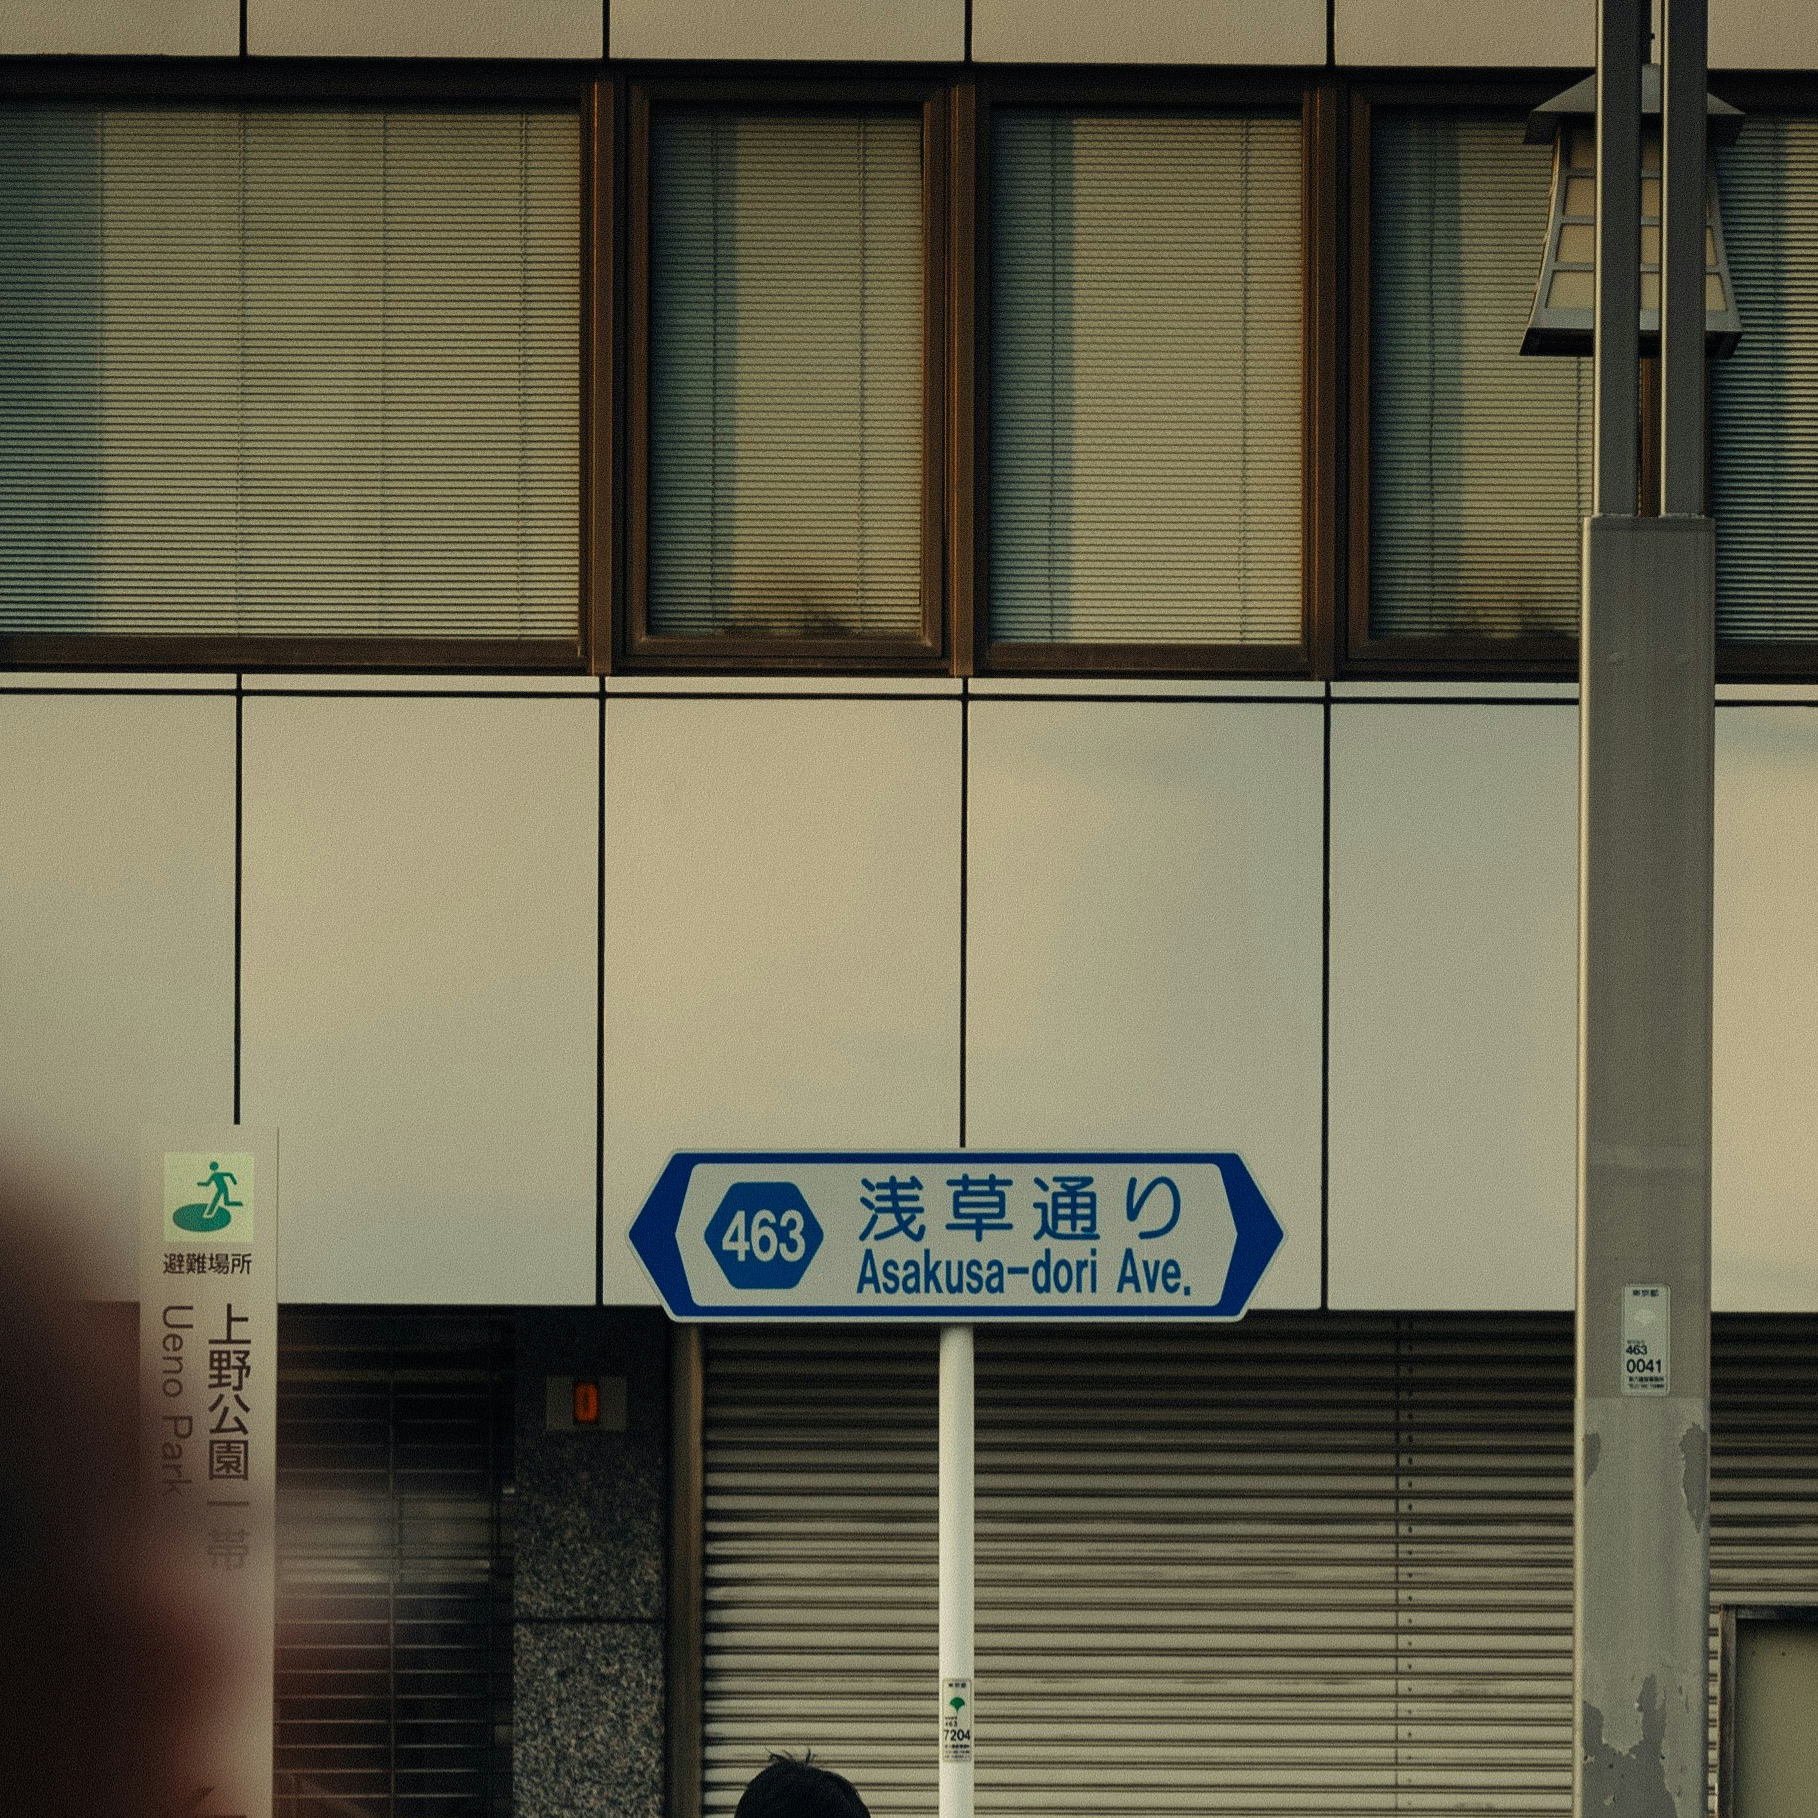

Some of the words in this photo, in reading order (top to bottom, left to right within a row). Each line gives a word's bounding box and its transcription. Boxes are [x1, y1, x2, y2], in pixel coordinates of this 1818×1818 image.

[859, 1174, 1182, 1243] 浅草通り
[721, 1208, 807, 1263] 463
[162, 1252, 253, 1276] 避難場所
[856, 1248, 1099, 1295] Asakusa-dori
[1116, 1250, 1192, 1296] Ave.
[161, 1305, 194, 1398] Ueno
[1626, 1345, 1648, 1355] 463
[1626, 1359, 1662, 1373] 0041
[161, 1413, 194, 1499] Park
[943, 1729, 971, 1741] 7204
